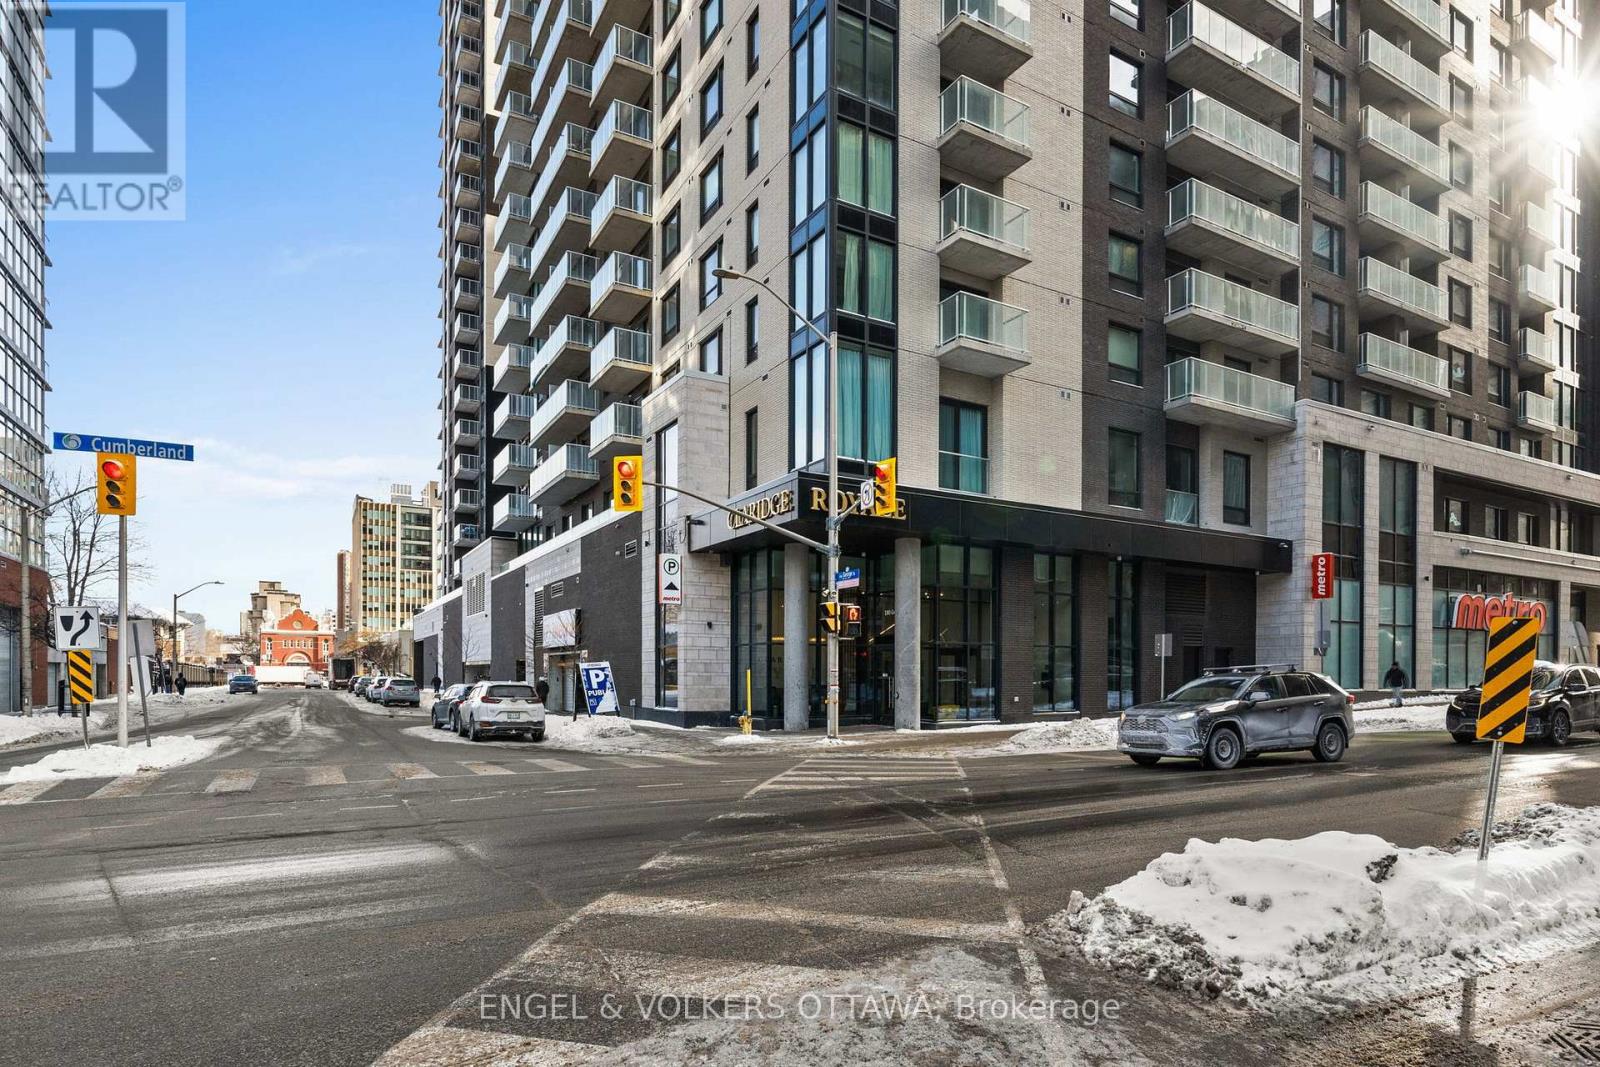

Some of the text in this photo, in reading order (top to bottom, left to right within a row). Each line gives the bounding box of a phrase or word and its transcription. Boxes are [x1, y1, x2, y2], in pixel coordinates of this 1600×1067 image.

[91, 437, 187, 460] Cumberland
[810, 486, 907, 521] ROYE
[668, 561, 677, 572] P
[1317, 556, 1326, 596] metro
[1452, 591, 1547, 633] metro
[588, 669, 605, 690] P
